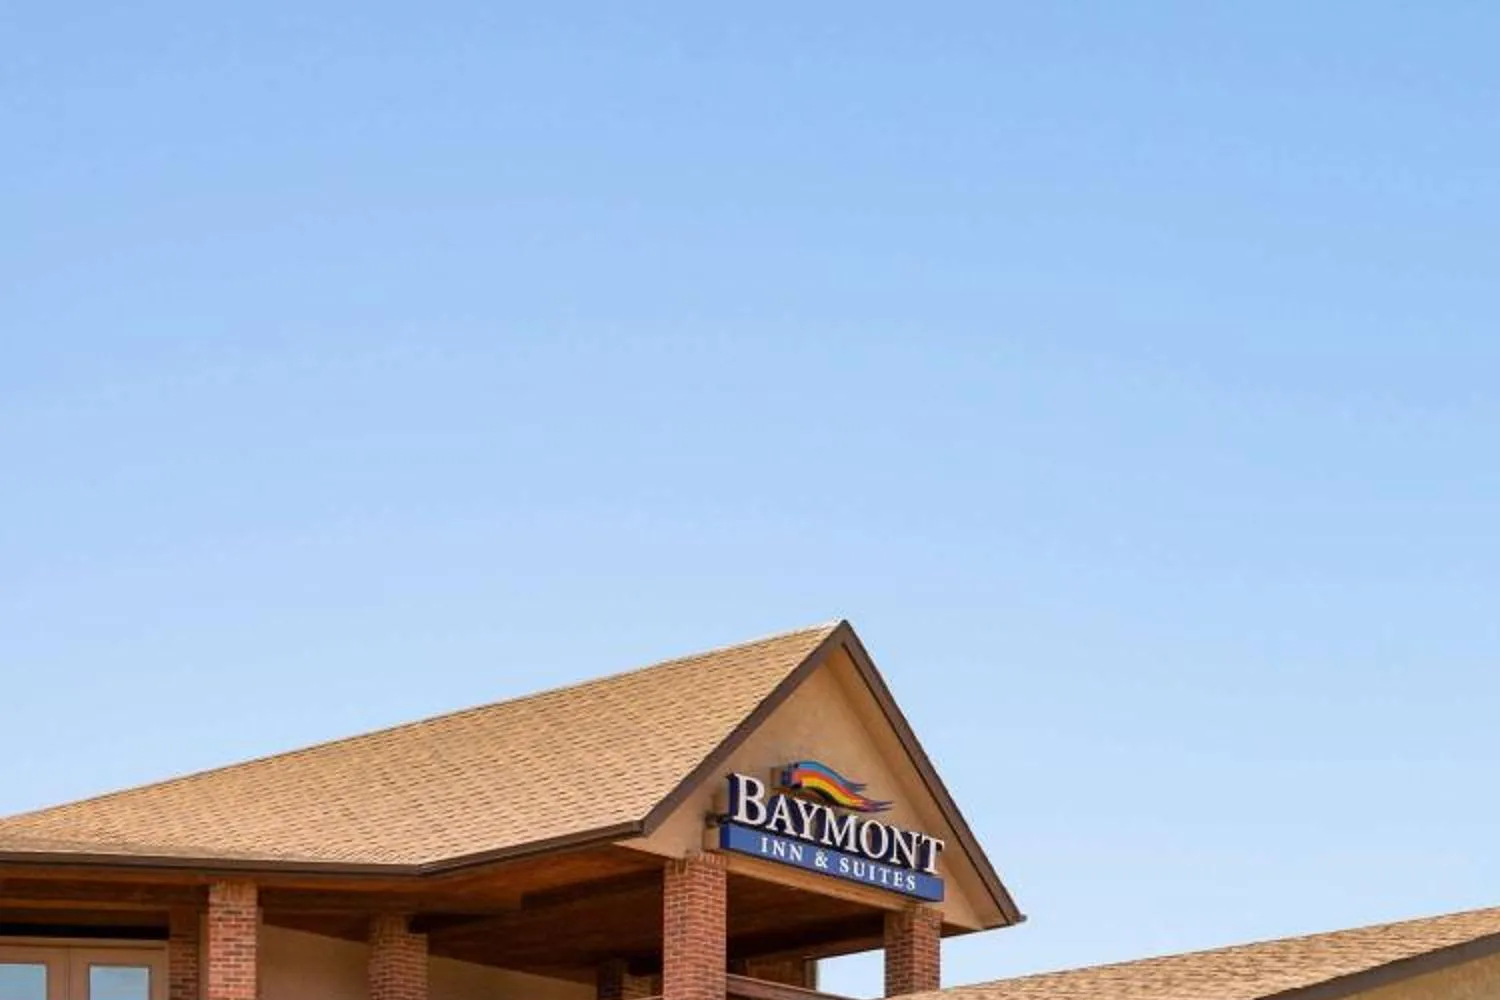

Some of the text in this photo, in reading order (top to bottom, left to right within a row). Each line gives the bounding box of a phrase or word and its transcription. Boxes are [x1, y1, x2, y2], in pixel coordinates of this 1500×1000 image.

[732, 772, 945, 875] BAYMONT
[760, 836, 917, 891] INN & SUITES
